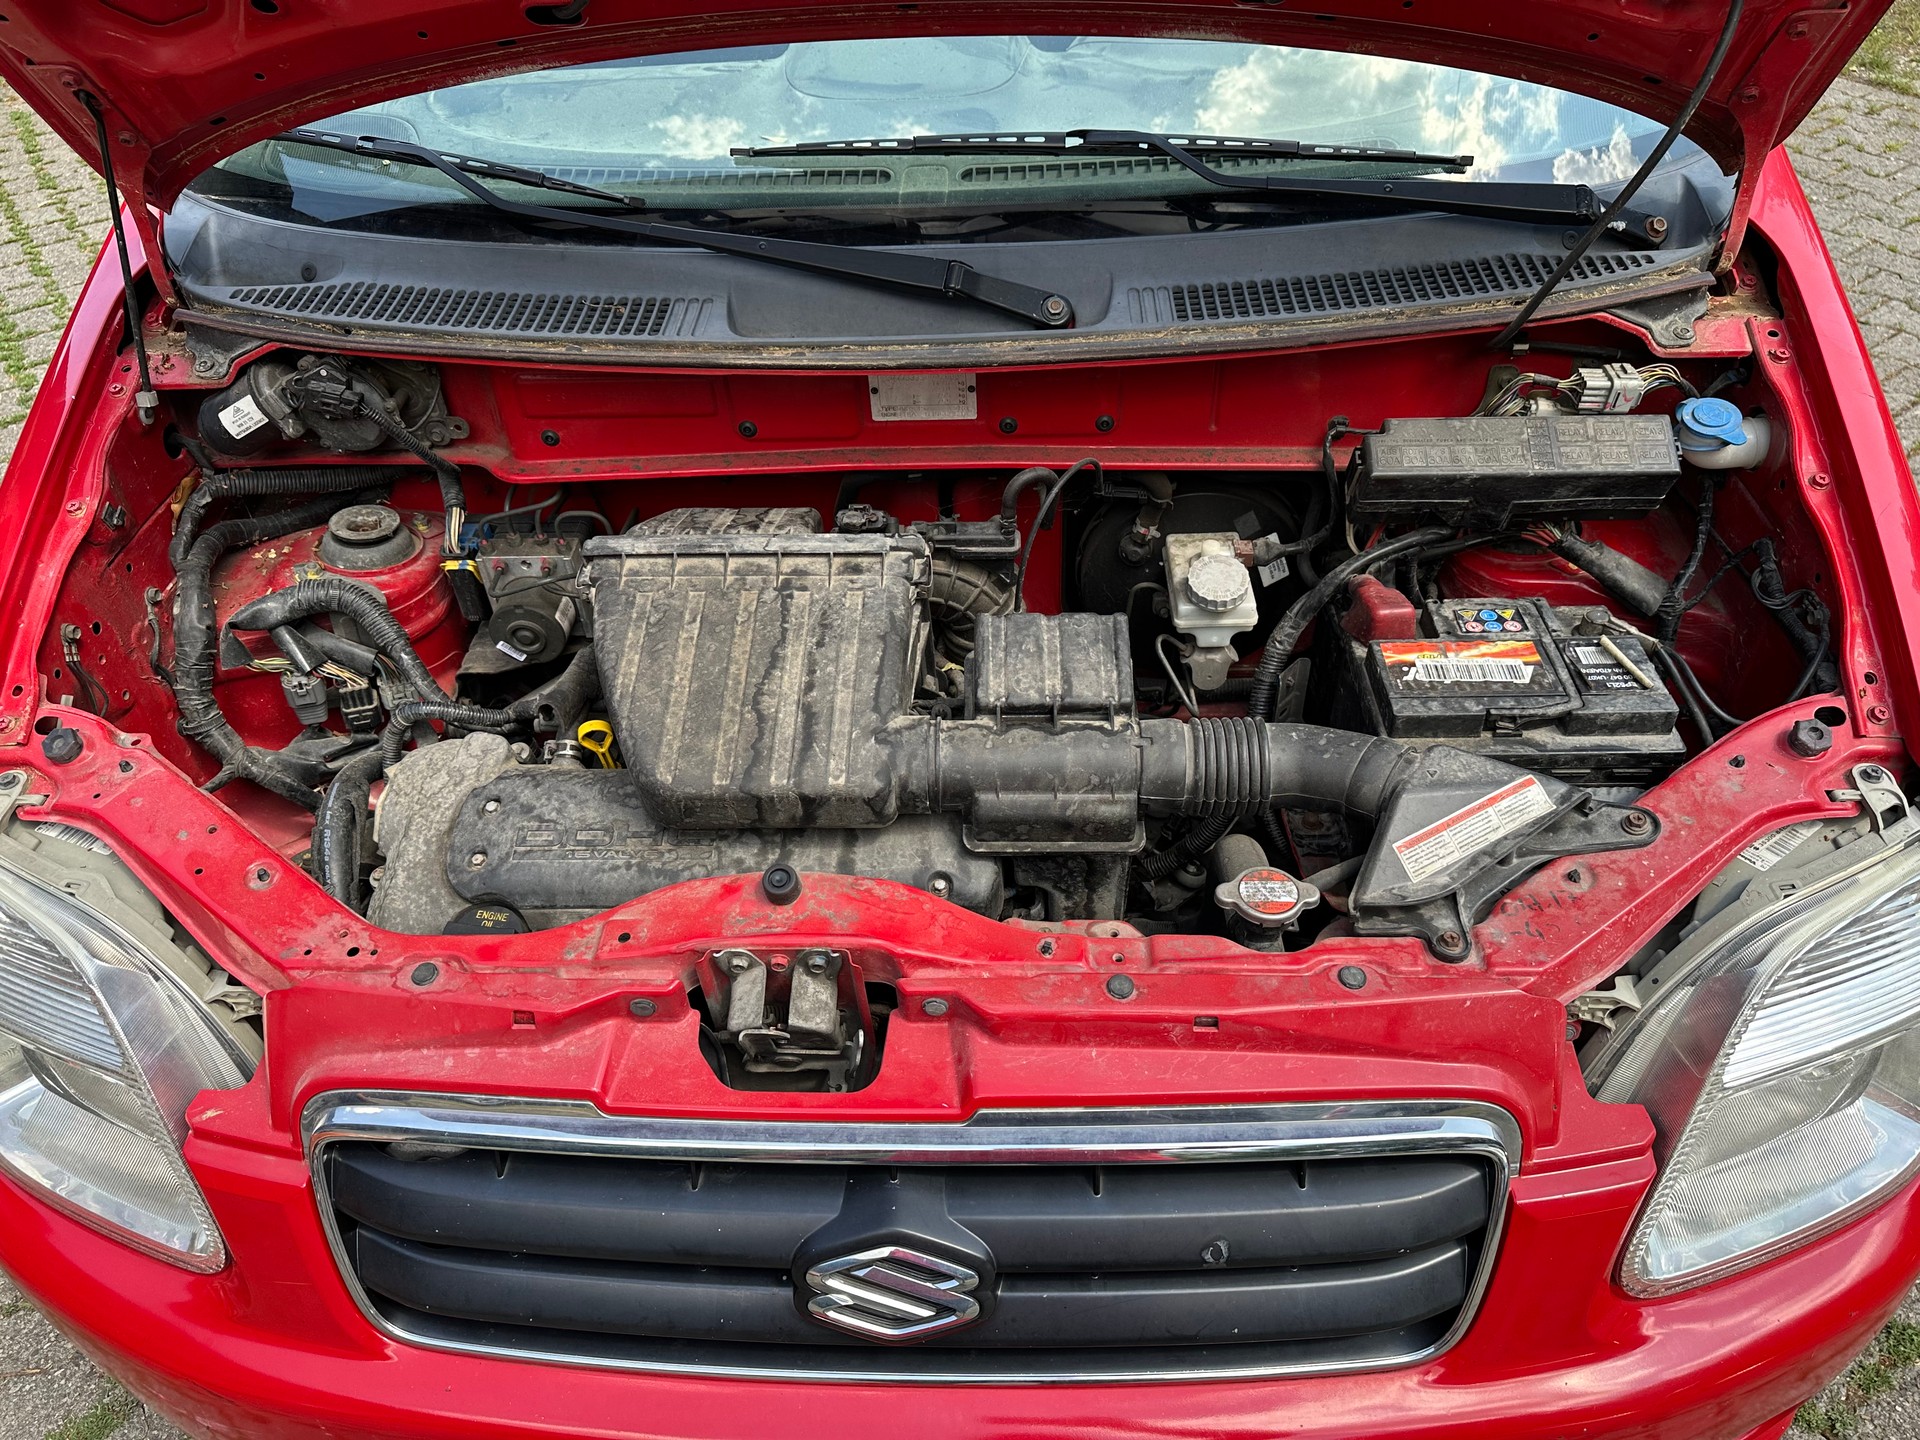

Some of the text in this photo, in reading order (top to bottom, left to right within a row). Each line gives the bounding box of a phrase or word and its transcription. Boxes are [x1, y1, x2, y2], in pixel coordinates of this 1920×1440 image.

[323, 828, 331, 862] R134a
[323, 864, 332, 884] ONLY
[476, 910, 509, 922] ENGINE
